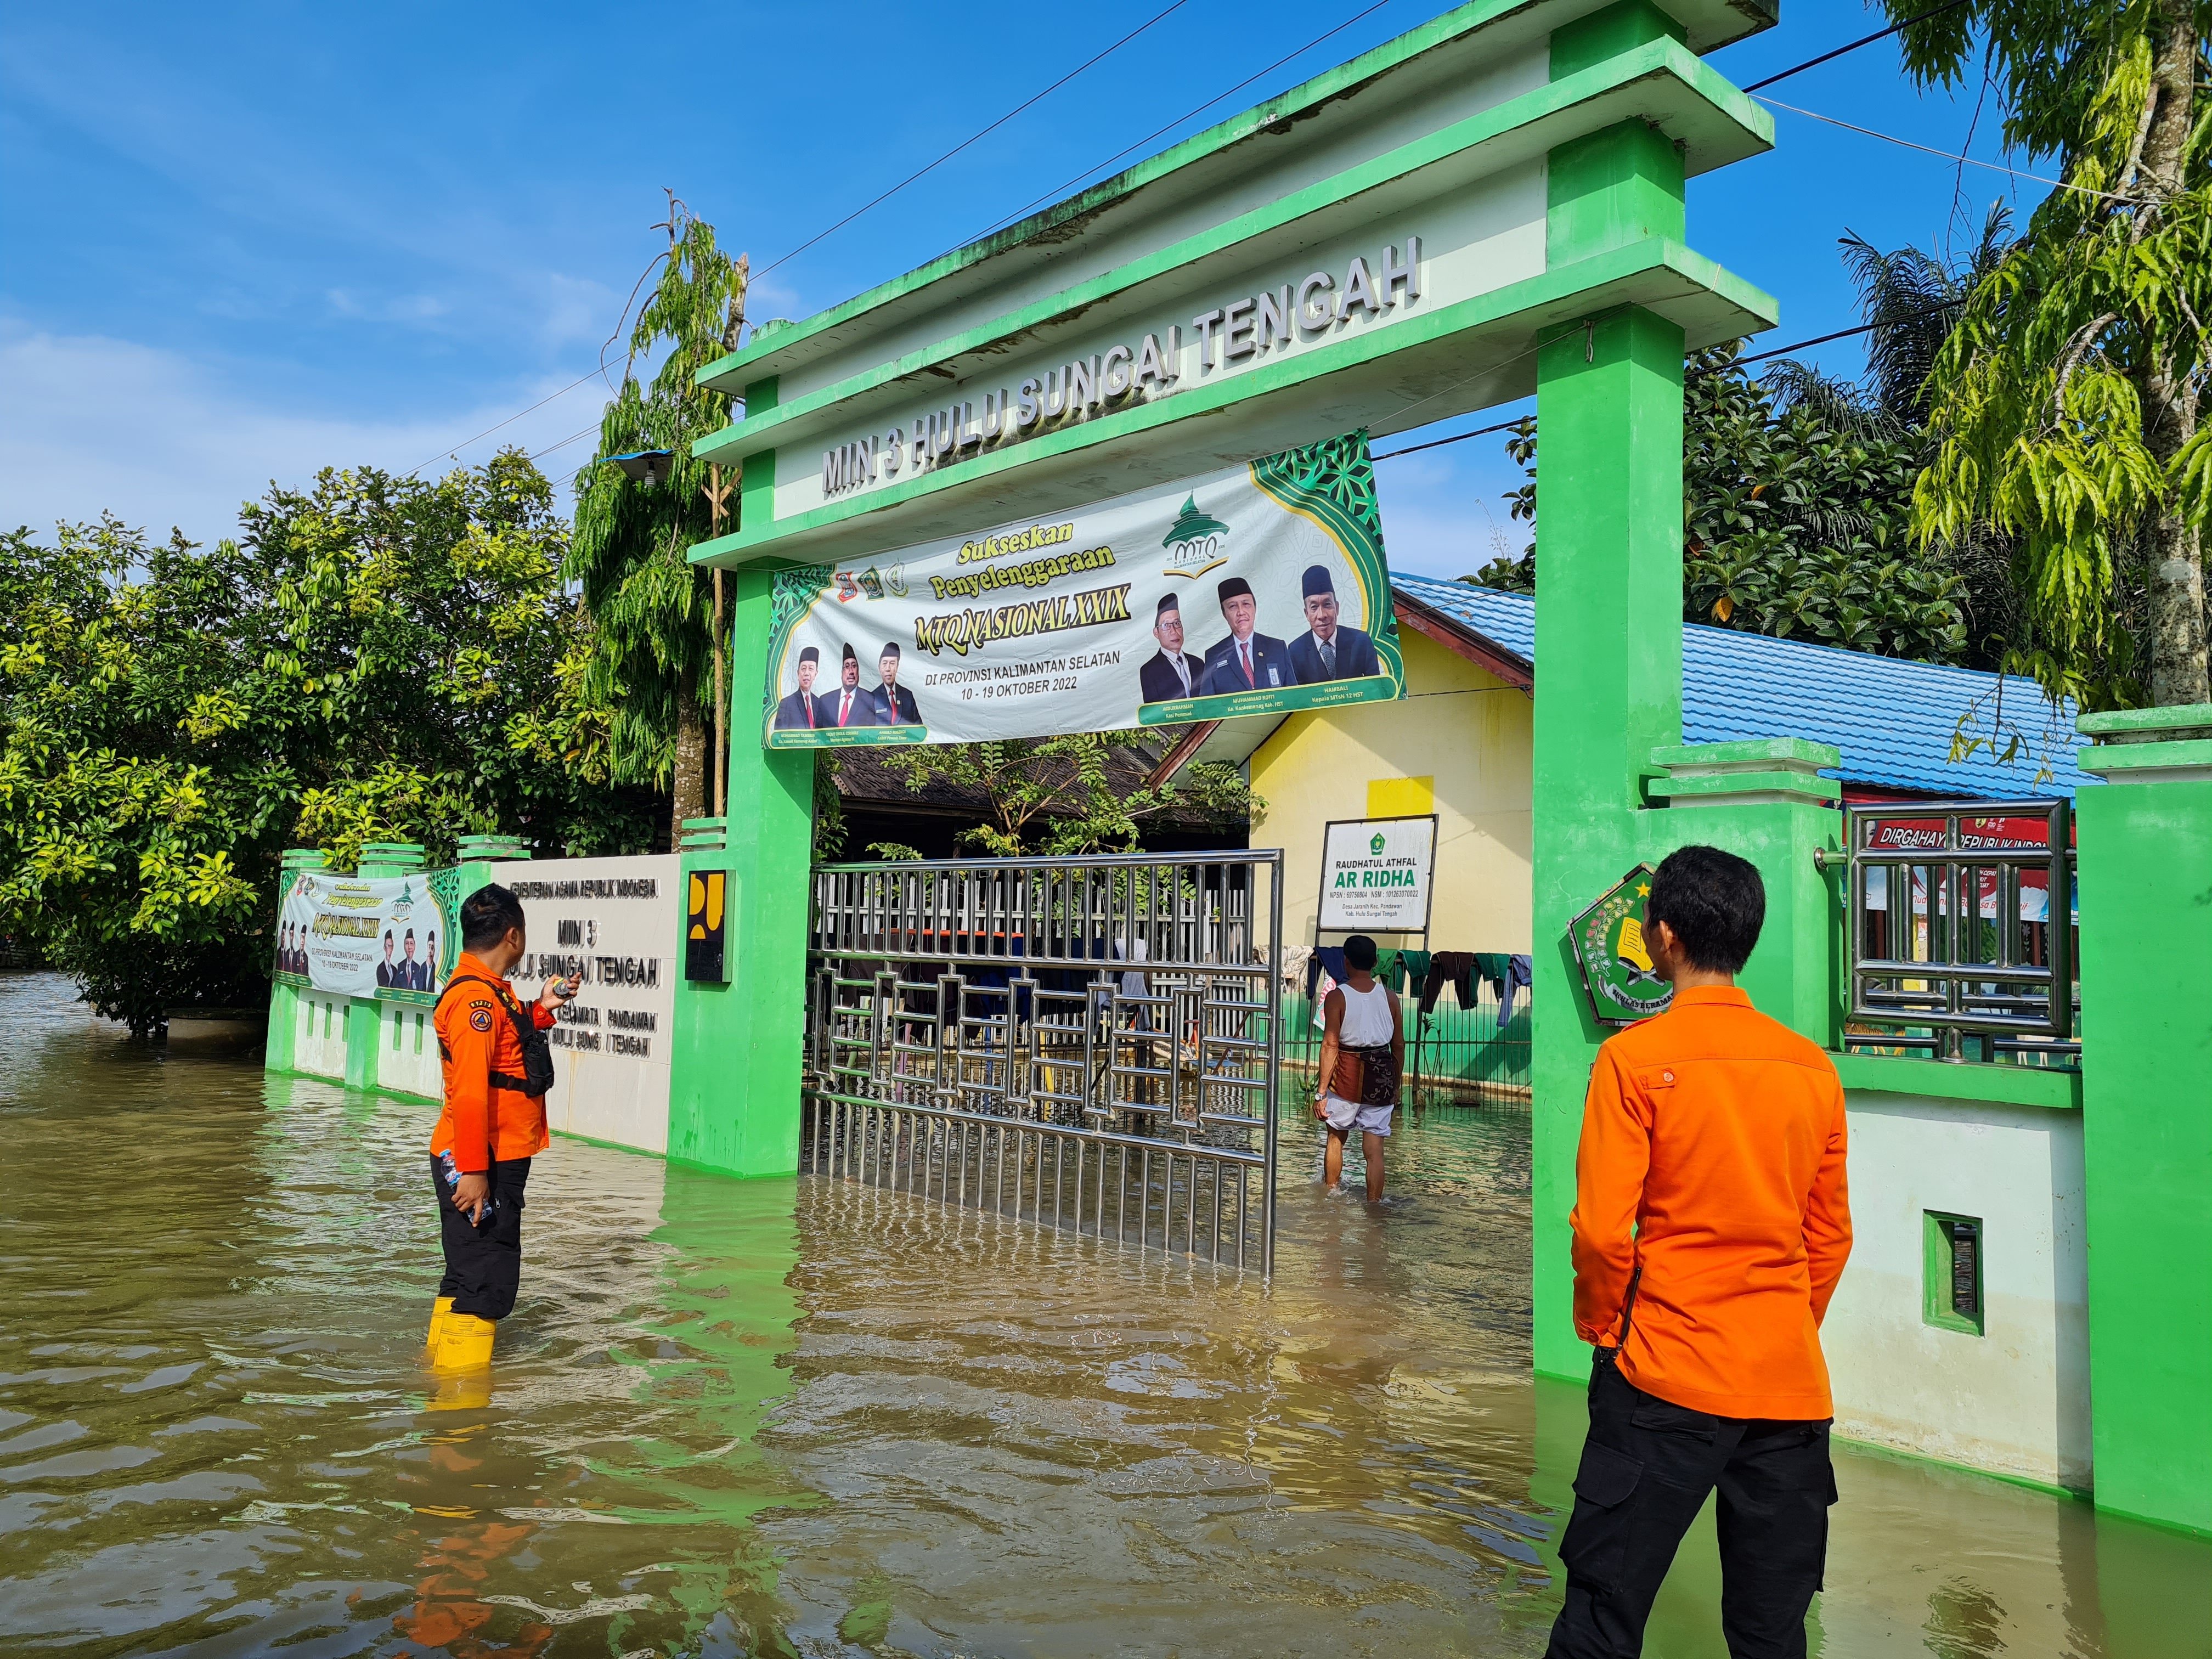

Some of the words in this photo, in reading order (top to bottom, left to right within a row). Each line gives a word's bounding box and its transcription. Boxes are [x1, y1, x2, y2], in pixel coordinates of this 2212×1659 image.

[822, 435, 878, 492] MIN
[884, 427, 904, 471] 3
[911, 390, 1007, 464] HULU
[1015, 325, 1181, 426] SUNGAI
[1193, 236, 1422, 368] TENGAH
[957, 523, 1074, 565] Sukseskan
[930, 546, 1116, 599] Penyelenggaraan
[915, 613, 968, 656] MTQ
[962, 595, 1071, 649] NASIONAL
[1069, 583, 1131, 629] XXIX
[926, 674, 938, 686] DI
[939, 667, 992, 685] PROVINSI
[994, 658, 1066, 680] KALIMANTAN
[1069, 651, 1120, 670] SELATAN
[961, 688, 972, 701] 10
[982, 686, 994, 699] 19
[996, 680, 1049, 698] OKTOBER
[1052, 676, 1077, 691] 2022
[1336, 859, 1384, 869] RAUDHATUL
[1386, 857, 1417, 867] ATHFAL
[580, 879, 616, 898] REPUBLIK
[617, 878, 659, 897] INDONESIA
[1334, 872, 1357, 888] AR
[1363, 870, 1415, 888] RIDHA
[557, 920, 585, 945] MIN
[586, 920, 598, 945] 3
[331, 950, 354, 960] KALIMANTAN
[354, 953, 373, 962] SELATAN
[331, 962, 349, 970] OKTOBER
[349, 963, 358, 972] 2022
[538, 953, 594, 983] SUNGAI
[595, 956, 661, 985] TENGAH
[1612, 989, 1640, 1008] IKHLAS
[608, 1009, 658, 1032] PANDAWAN
[611, 1034, 651, 1058] TENGAH
